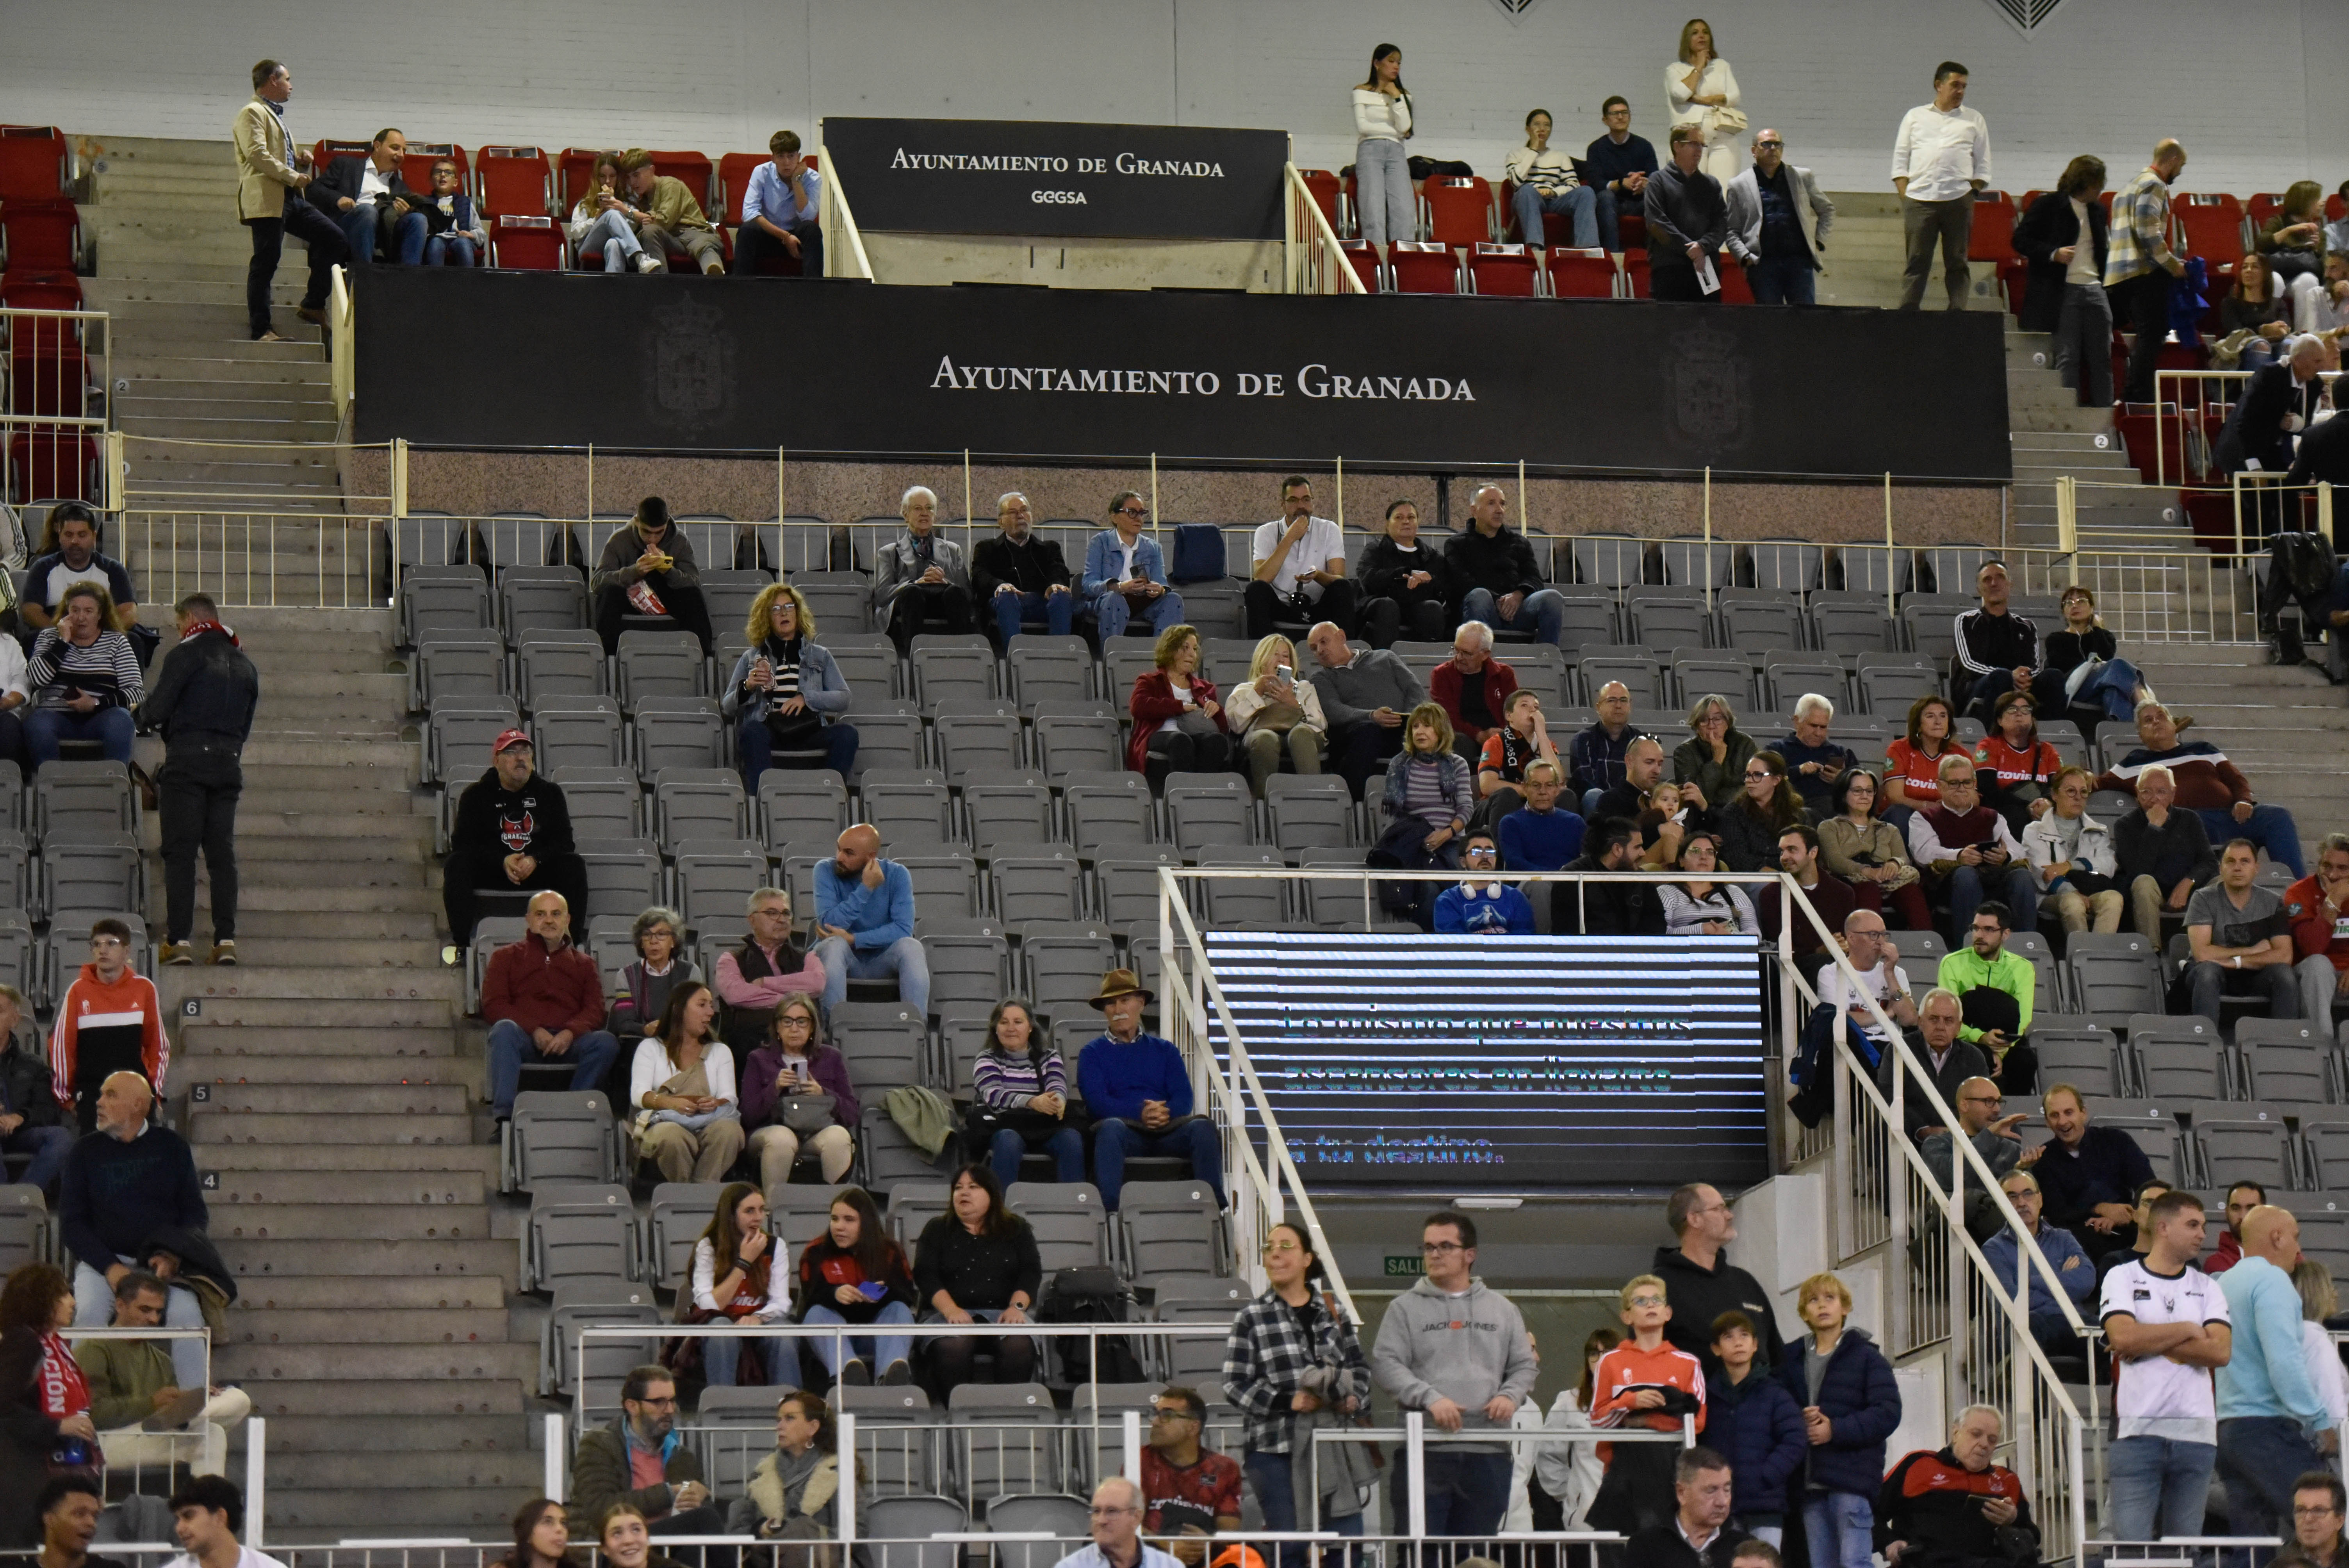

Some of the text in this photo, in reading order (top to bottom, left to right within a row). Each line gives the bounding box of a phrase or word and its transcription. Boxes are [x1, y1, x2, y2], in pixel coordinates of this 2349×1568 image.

[891, 148, 1225, 177] AYUNTAMIENTO DE GRANADA
[930, 355, 1476, 401] AYUNTAMIENTO DE GRANADA
[119, 382, 125, 391] 2
[2098, 437, 2104, 446] 2
[2167, 511, 2172, 520] 1
[187, 1001, 197, 1014] 6
[196, 1087, 206, 1099] 5
[204, 1174, 215, 1187] 4
[1422, 1321, 1450, 1332] JACK
